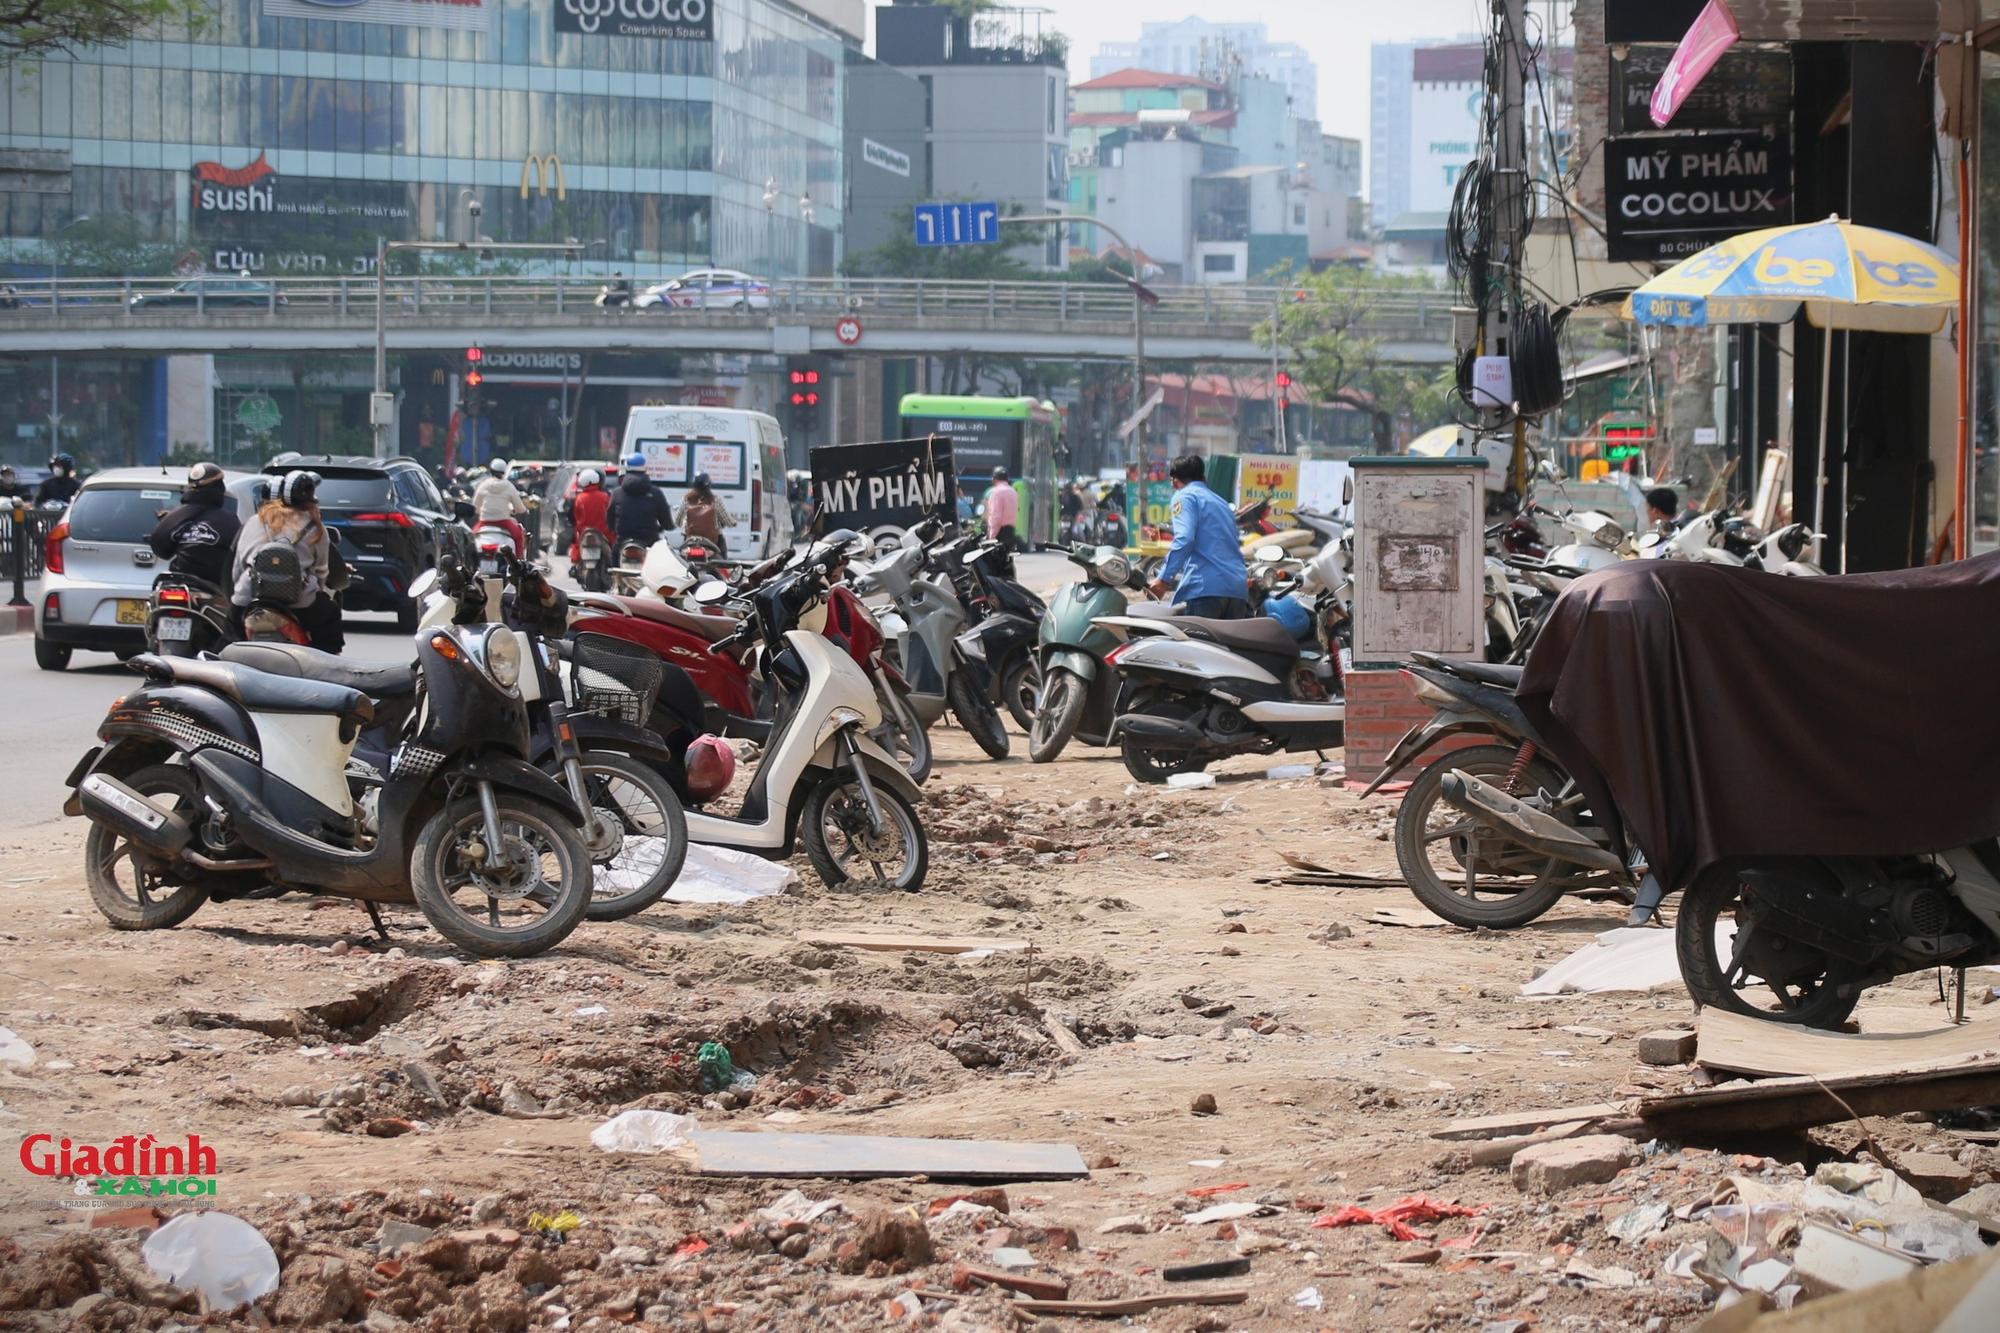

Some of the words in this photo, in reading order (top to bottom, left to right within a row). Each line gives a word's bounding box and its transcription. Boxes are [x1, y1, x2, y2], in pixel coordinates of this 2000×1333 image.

[620, 24, 674, 37] Coworking
[676, 26, 706, 39] Space
[1627, 150, 1671, 181] MỸ
[1682, 139, 1768, 178] PHẨM
[1621, 188, 1775, 218] COCOLUX
[1660, 243, 1674, 253] 80
[1754, 246, 1835, 285] be
[1854, 250, 1939, 288] be
[1676, 301, 1693, 318] XE
[822, 470, 862, 513] MỸ
[869, 457, 946, 510] PHẨM
